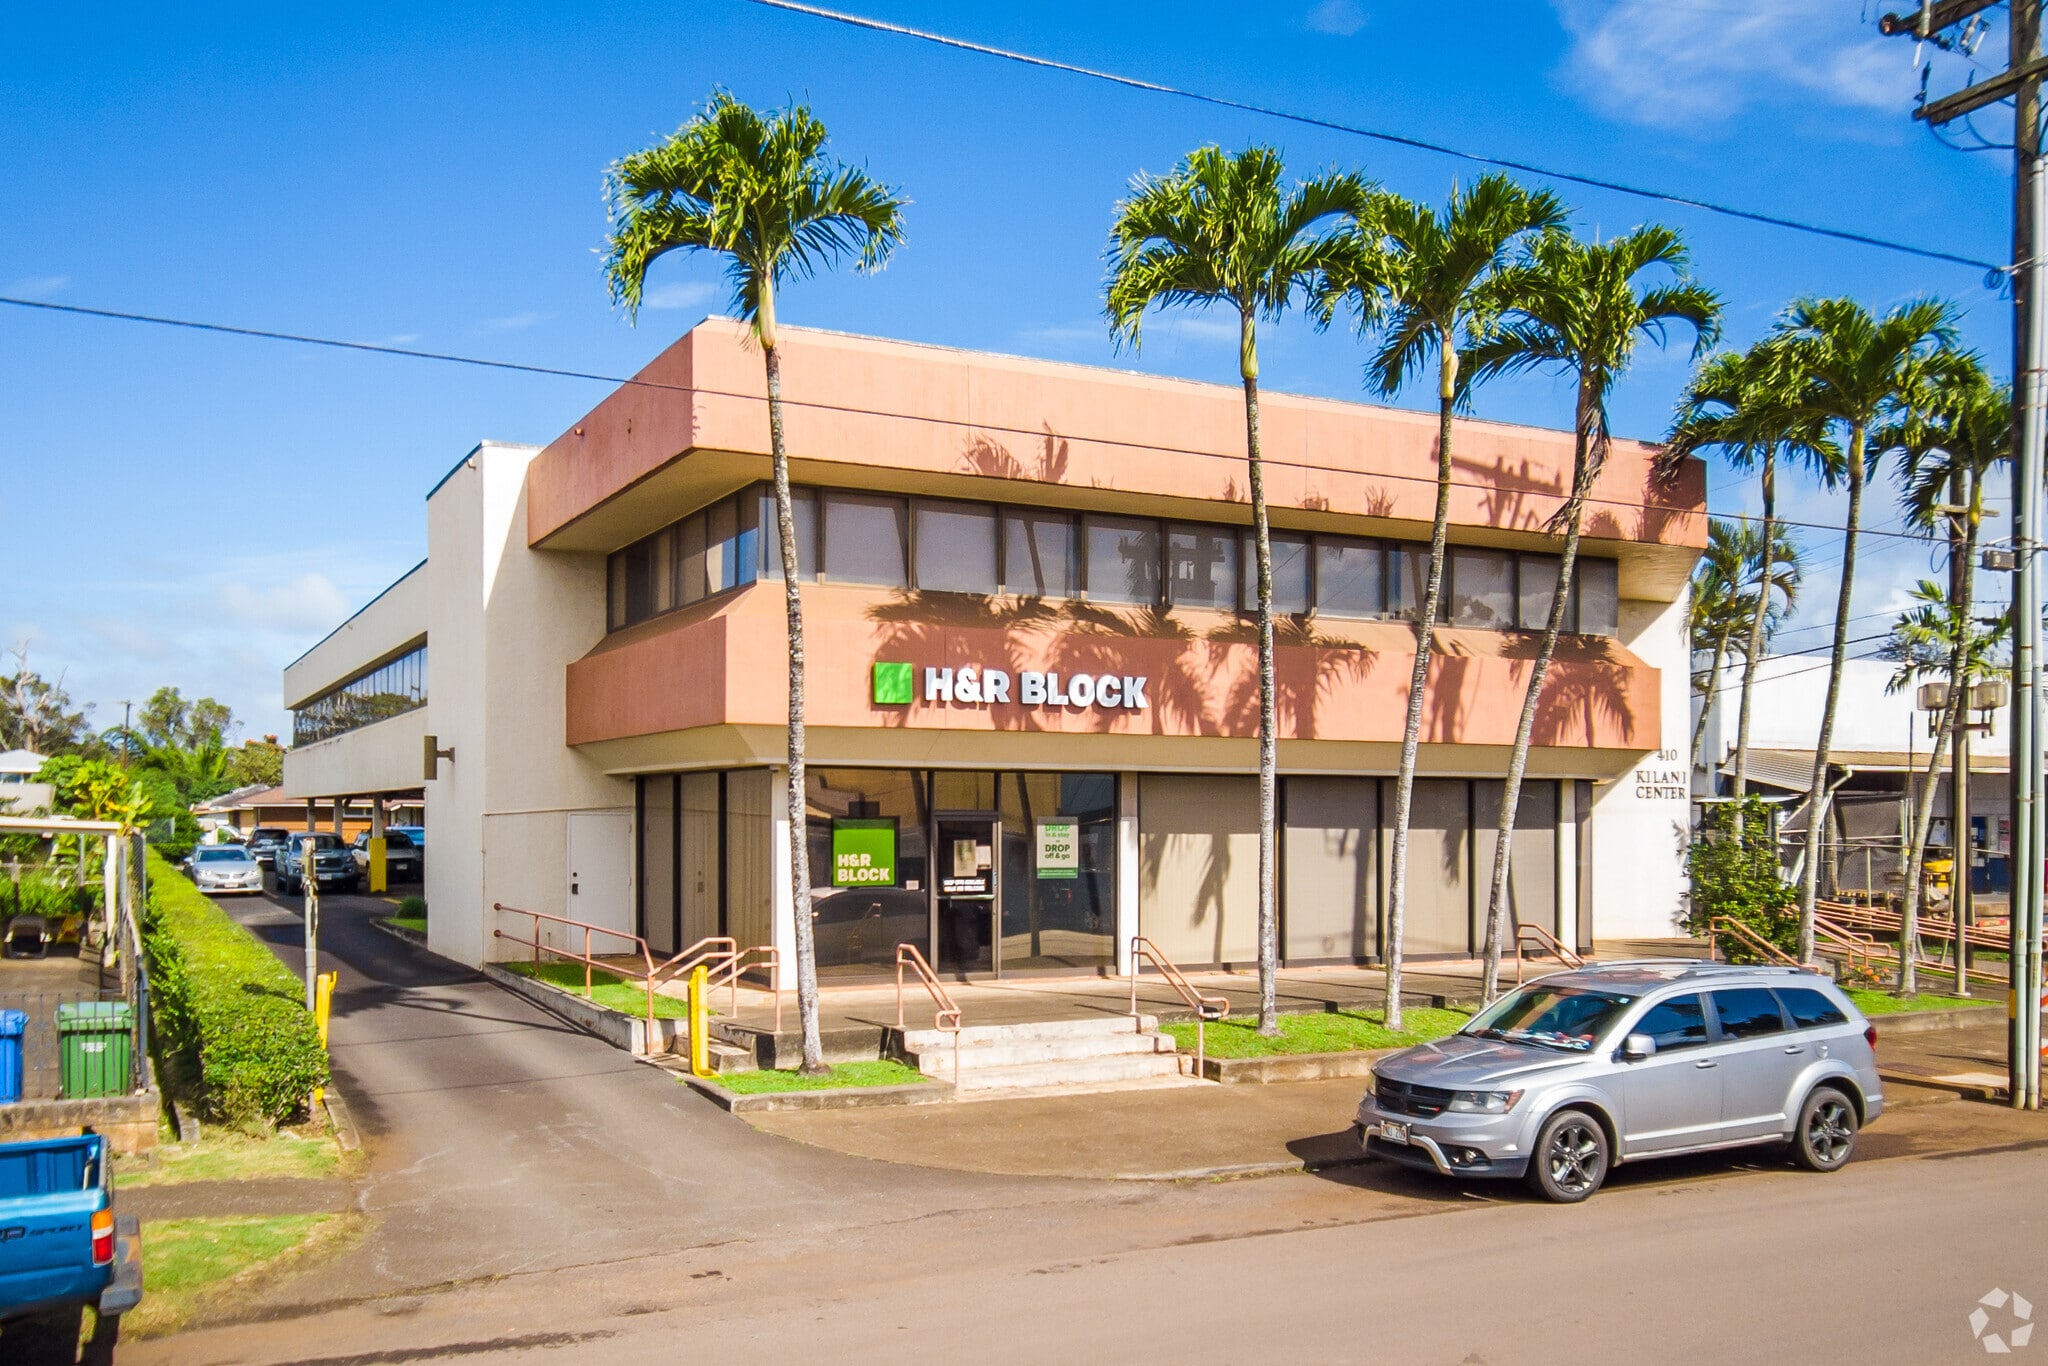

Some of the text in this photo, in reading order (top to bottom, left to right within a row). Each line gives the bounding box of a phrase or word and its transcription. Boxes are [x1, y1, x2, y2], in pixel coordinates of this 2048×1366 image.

[925, 667, 1149, 708] H&R BLOCK
[1657, 749, 1678, 761] 410
[1636, 770, 1687, 784] KILANI
[1635, 786, 1686, 799] CENTER
[1045, 844, 1070, 852] DROP
[837, 853, 871, 867] H&R
[837, 868, 890, 882] BLOCK
